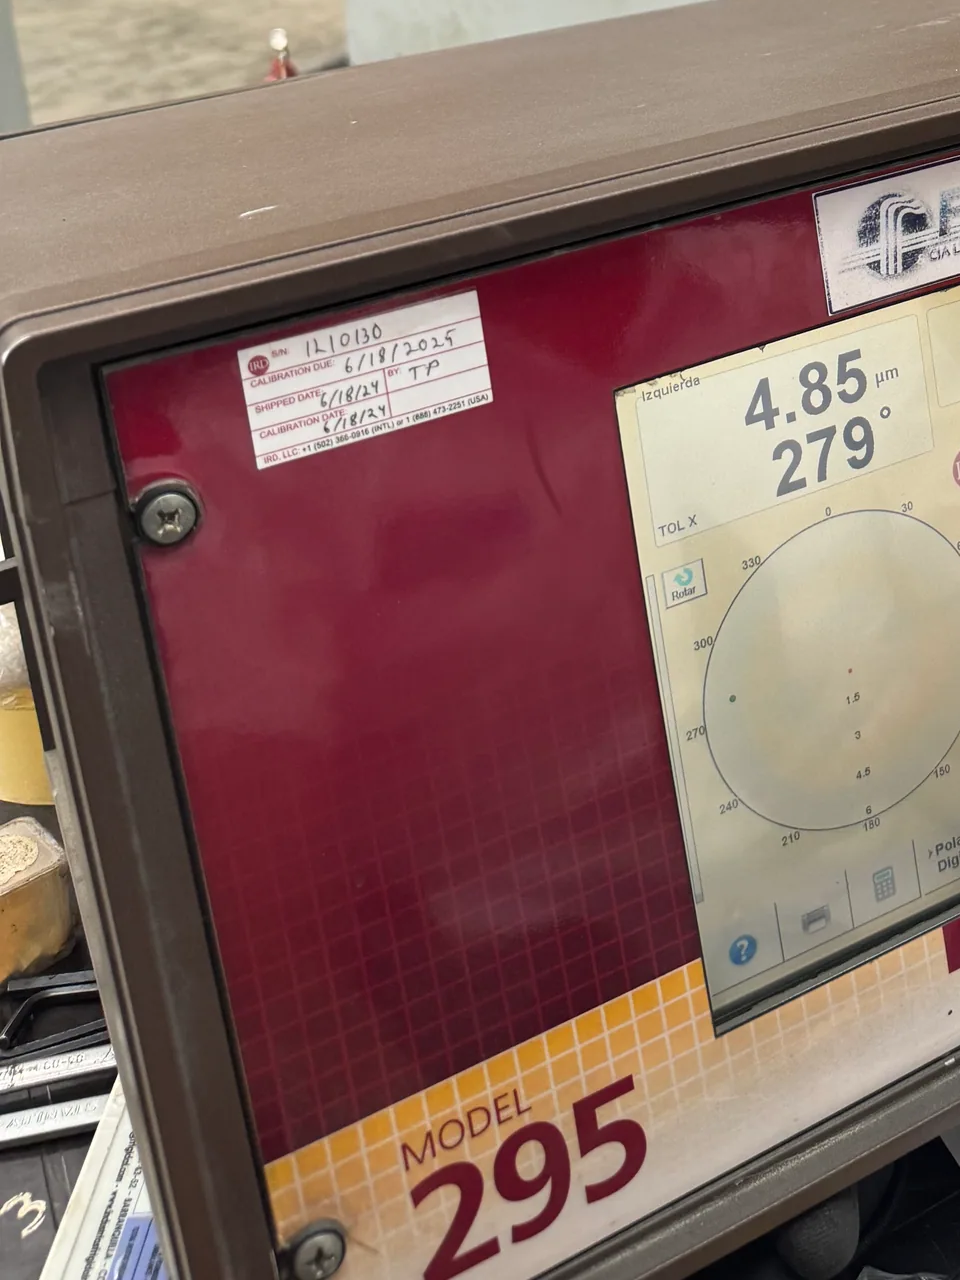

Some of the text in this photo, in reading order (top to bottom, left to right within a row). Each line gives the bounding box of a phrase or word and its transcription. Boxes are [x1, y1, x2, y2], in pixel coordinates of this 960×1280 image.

[929, 243, 952, 262] CIA
[249, 359, 269, 372] IRD
[250, 363, 312, 388] CALIBRATION
[313, 358, 336, 372] DUE:
[641, 375, 701, 403] Izquierda
[745, 348, 867, 431] 4.85
[255, 395, 296, 414] SHIPPED
[297, 388, 324, 403] DATE:
[371, 421, 395, 435] (INTL)
[467, 392, 489, 408] (USA)
[259, 416, 321, 440] CALIBRATION
[322, 408, 348, 423] DATE:
[901, 500, 914, 513] 30
[658, 514, 698, 538] TOL X
[742, 555, 761, 571] 330
[671, 584, 697, 601] Rotar
[693, 636, 713, 651] 300
[846, 691, 861, 705] 1.5
[686, 725, 706, 742] 270
[856, 766, 871, 780] 4.5
[933, 764, 951, 778] 150
[719, 798, 739, 814] 240
[863, 817, 881, 832] 180
[781, 831, 801, 846] 210
[401, 1088, 532, 1171] MODEL
[410, 1073, 648, 1280] 295
